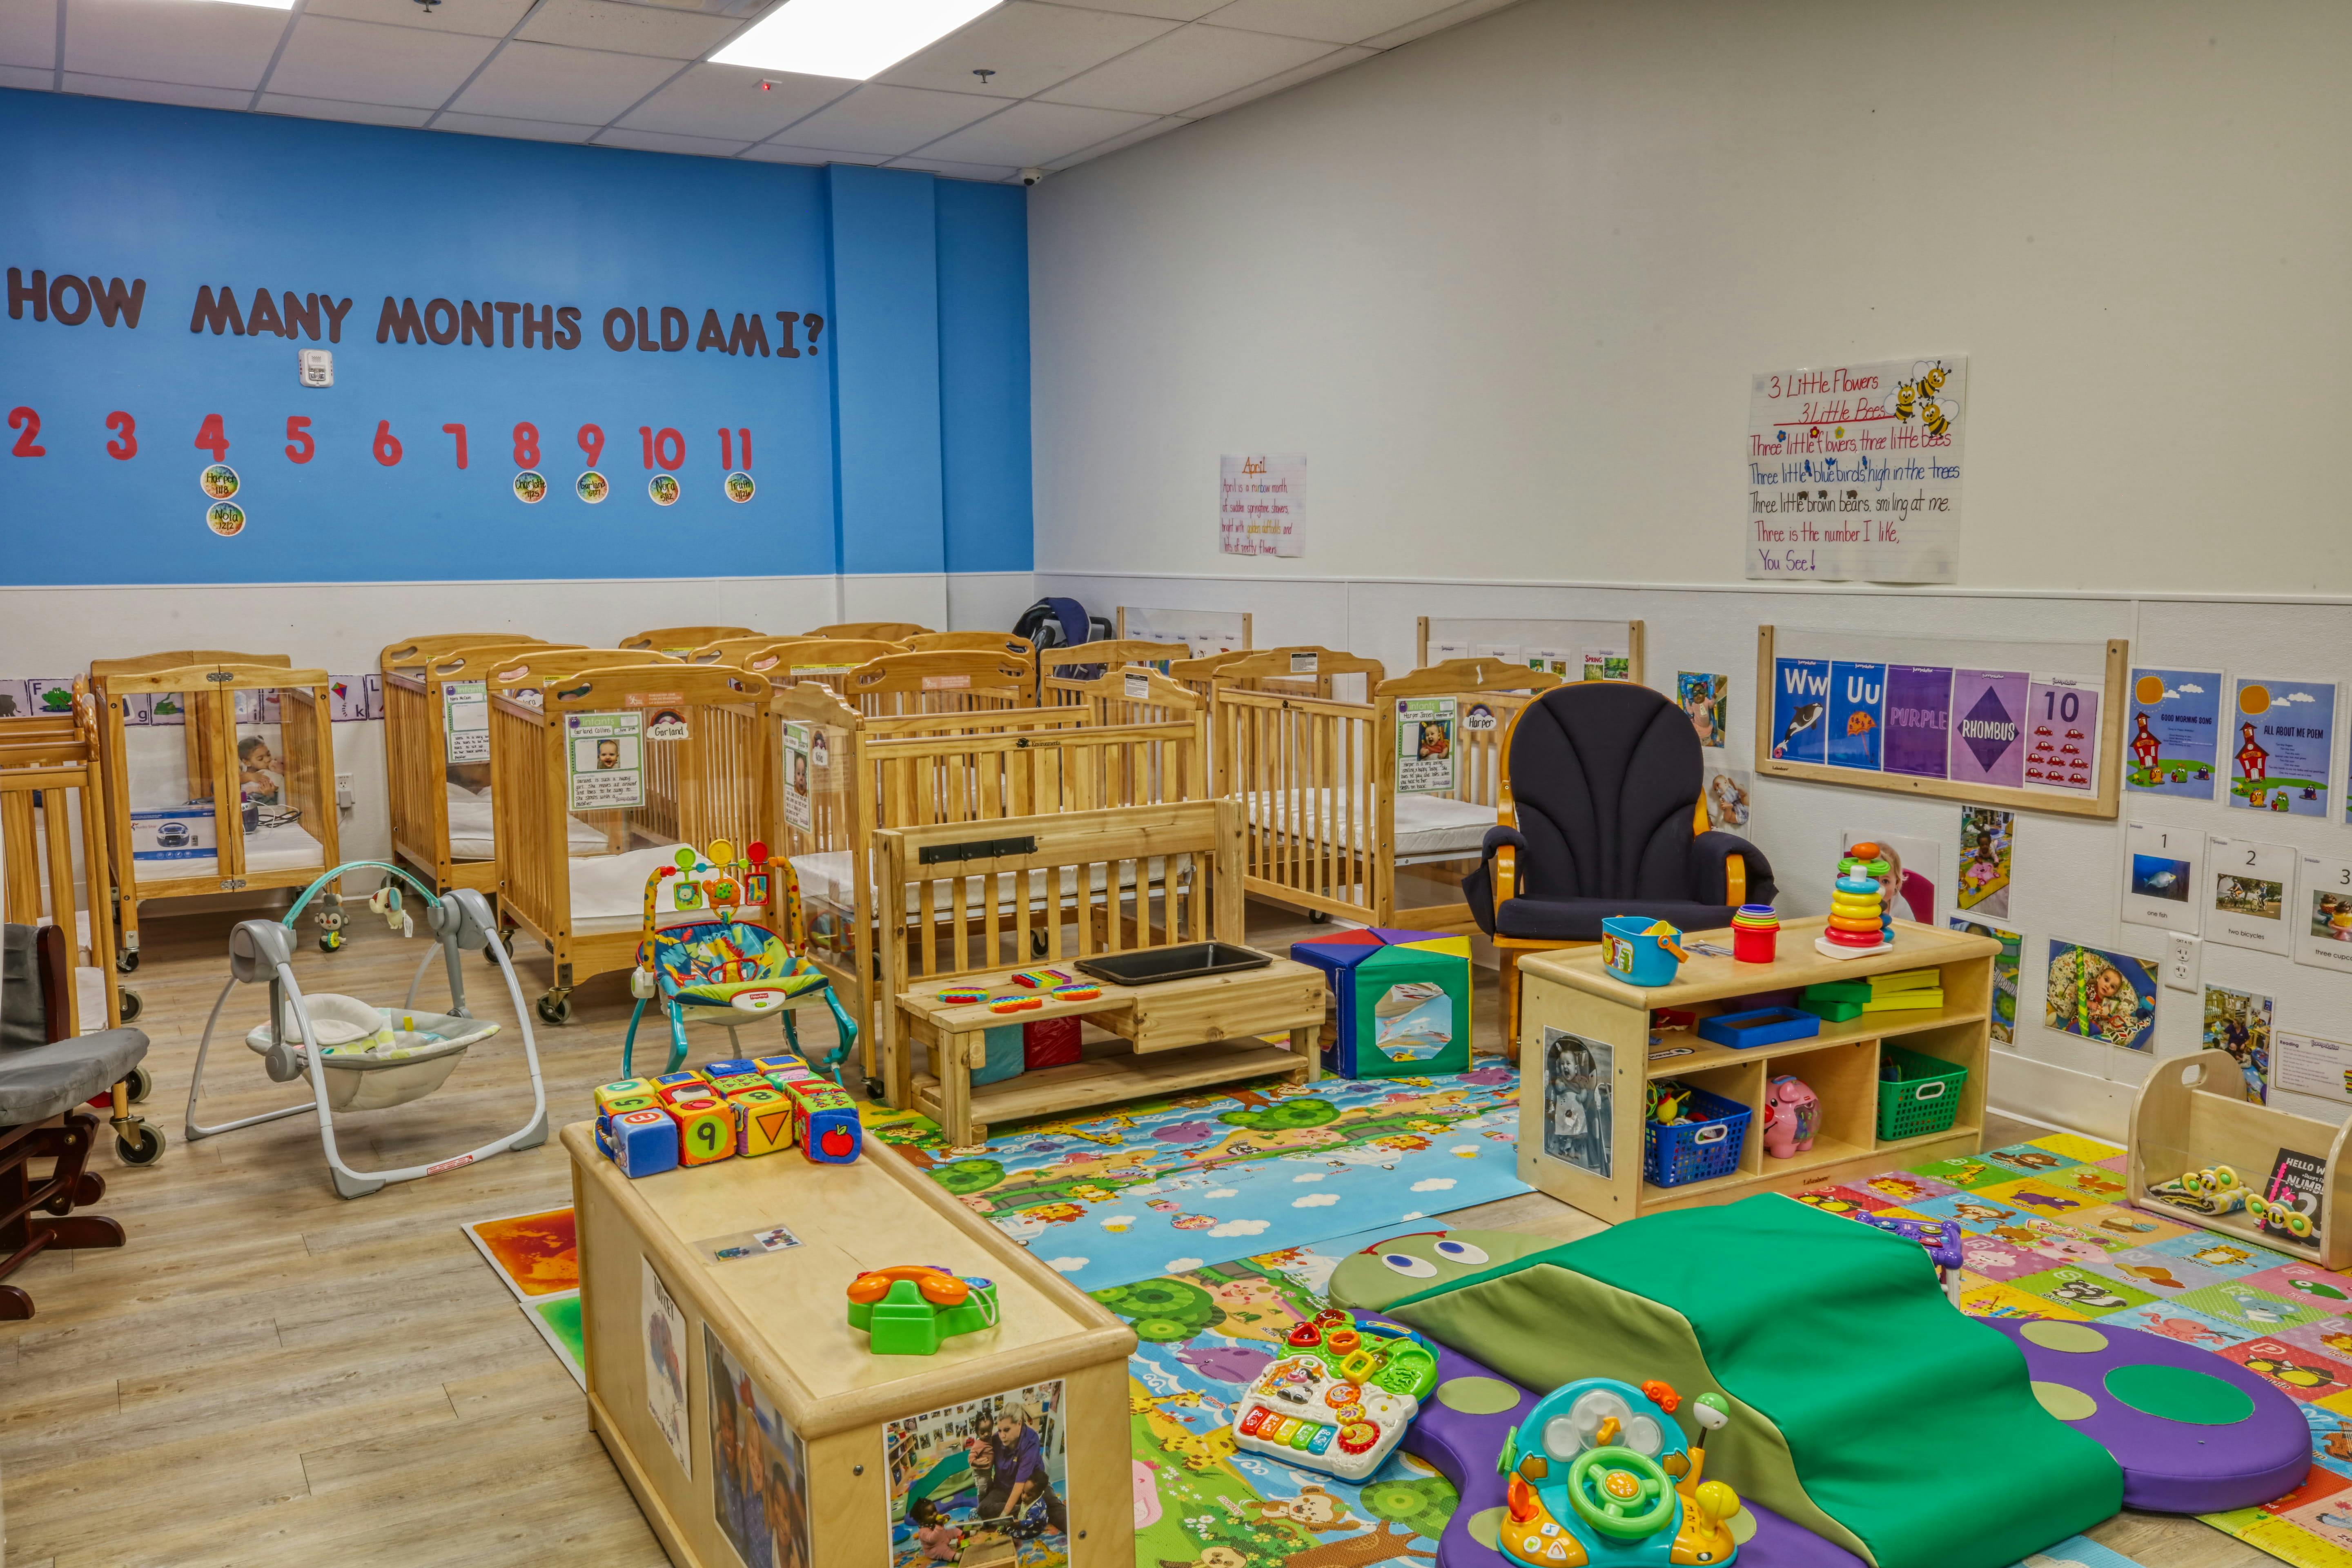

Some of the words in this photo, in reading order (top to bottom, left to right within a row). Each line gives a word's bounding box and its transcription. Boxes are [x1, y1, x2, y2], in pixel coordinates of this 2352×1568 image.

[7, 267, 146, 329] HOW
[189, 285, 353, 344] MANY
[376, 296, 581, 350] MONTHS
[603, 306, 689, 352] OLD
[696, 309, 770, 358] AM
[776, 311, 824, 359] I?
[1768, 376, 1781, 399] 3
[1786, 371, 1830, 398] Little
[1833, 368, 1879, 395] Flowers
[1798, 403, 1811, 424] 3
[1811, 400, 1850, 423] Little
[1855, 397, 1886, 421] Bees
[8, 406, 46, 457] 2
[106, 411, 138, 460] 3
[194, 413, 230, 462] 4
[285, 416, 315, 464] 5
[372, 419, 403, 466] 6
[442, 423, 468, 470] 7
[512, 421, 541, 469] 8
[577, 423, 605, 468] 9
[639, 426, 685, 470] 10
[717, 428, 752, 470] 11
[1750, 435, 1782, 456] Three
[1786, 434, 1814, 454] little
[1859, 429, 1886, 452] three
[1890, 426, 1919, 449] little
[1921, 427, 1952, 448] bees
[1243, 456, 1266, 479] April
[1749, 462, 1779, 485] Three
[1782, 462, 1806, 484] little
[1868, 458, 1890, 491] high
[1893, 464, 1904, 480] in
[1904, 458, 1925, 479] the
[1928, 455, 1960, 479] trees
[207, 473, 236, 484] Harper
[515, 479, 546, 490] Charlotte
[580, 479, 606, 489] Garland
[655, 479, 675, 492] Nora
[728, 479, 750, 490] Truth
[525, 490, 539, 499] 7/25
[1223, 478, 1236, 498] April
[660, 493, 673, 501] 5/12
[1230, 500, 1244, 513] sudden
[1750, 491, 1777, 513] Three
[1780, 491, 1803, 513] little
[1807, 490, 1835, 512] brown
[1876, 492, 1908, 521] smiling
[1911, 488, 1924, 512] at
[1929, 498, 1950, 512] me.
[215, 510, 238, 522] Nola
[1283, 523, 1293, 535] and
[1754, 520, 1785, 542] Three
[1789, 526, 1797, 541] is
[1800, 521, 1820, 541] the
[1824, 520, 1860, 542] number
[1863, 520, 1872, 542] I
[1879, 521, 1900, 543] like,
[1241, 540, 1256, 555] pretty
[1759, 549, 1780, 570] You
[1786, 549, 1816, 572] See!
[33, 682, 42, 695] F
[370, 679, 379, 692] L
[1784, 668, 1829, 696] Ww
[1847, 676, 1880, 704] Uu
[356, 704, 365, 717] k
[2044, 691, 2079, 723] 10
[139, 710, 148, 722] g
[583, 717, 615, 726] infants
[1469, 718, 1494, 728] Harper
[1890, 706, 1948, 731] PURPLE
[2161, 714, 2174, 722] GOOD
[2175, 715, 2198, 724] MORNING
[655, 726, 684, 736] Garland
[1962, 719, 2016, 742] RHOMBUS
[2264, 725, 2274, 735] ALL
[2276, 726, 2295, 737] ABOUT
[2296, 728, 2305, 738] ME
[2307, 728, 2323, 739] POEM
[2161, 834, 2167, 849] 1
[2246, 850, 2257, 866] 2
[2340, 869, 2351, 885] 3
[2158, 911, 2168, 919] fish
[2241, 930, 2265, 940] bicycles
[697, 1122, 715, 1151] 9
[2286, 1157, 2314, 1172] HELLO
[2010, 1200, 2035, 1210] hippo
[1936, 1213, 1971, 1226] monkey
[2098, 1227, 2129, 1240] cream
[2118, 1274, 2138, 1283] nut
[653, 1274, 674, 1321] TURKEY
[2040, 1292, 2071, 1306] skunk
[1261, 1326, 1278, 1338] skunk
[2328, 1349, 2352, 1361] lion
[1203, 1396, 1227, 1410] giraffe
[1217, 1495, 1245, 1515] monkey
